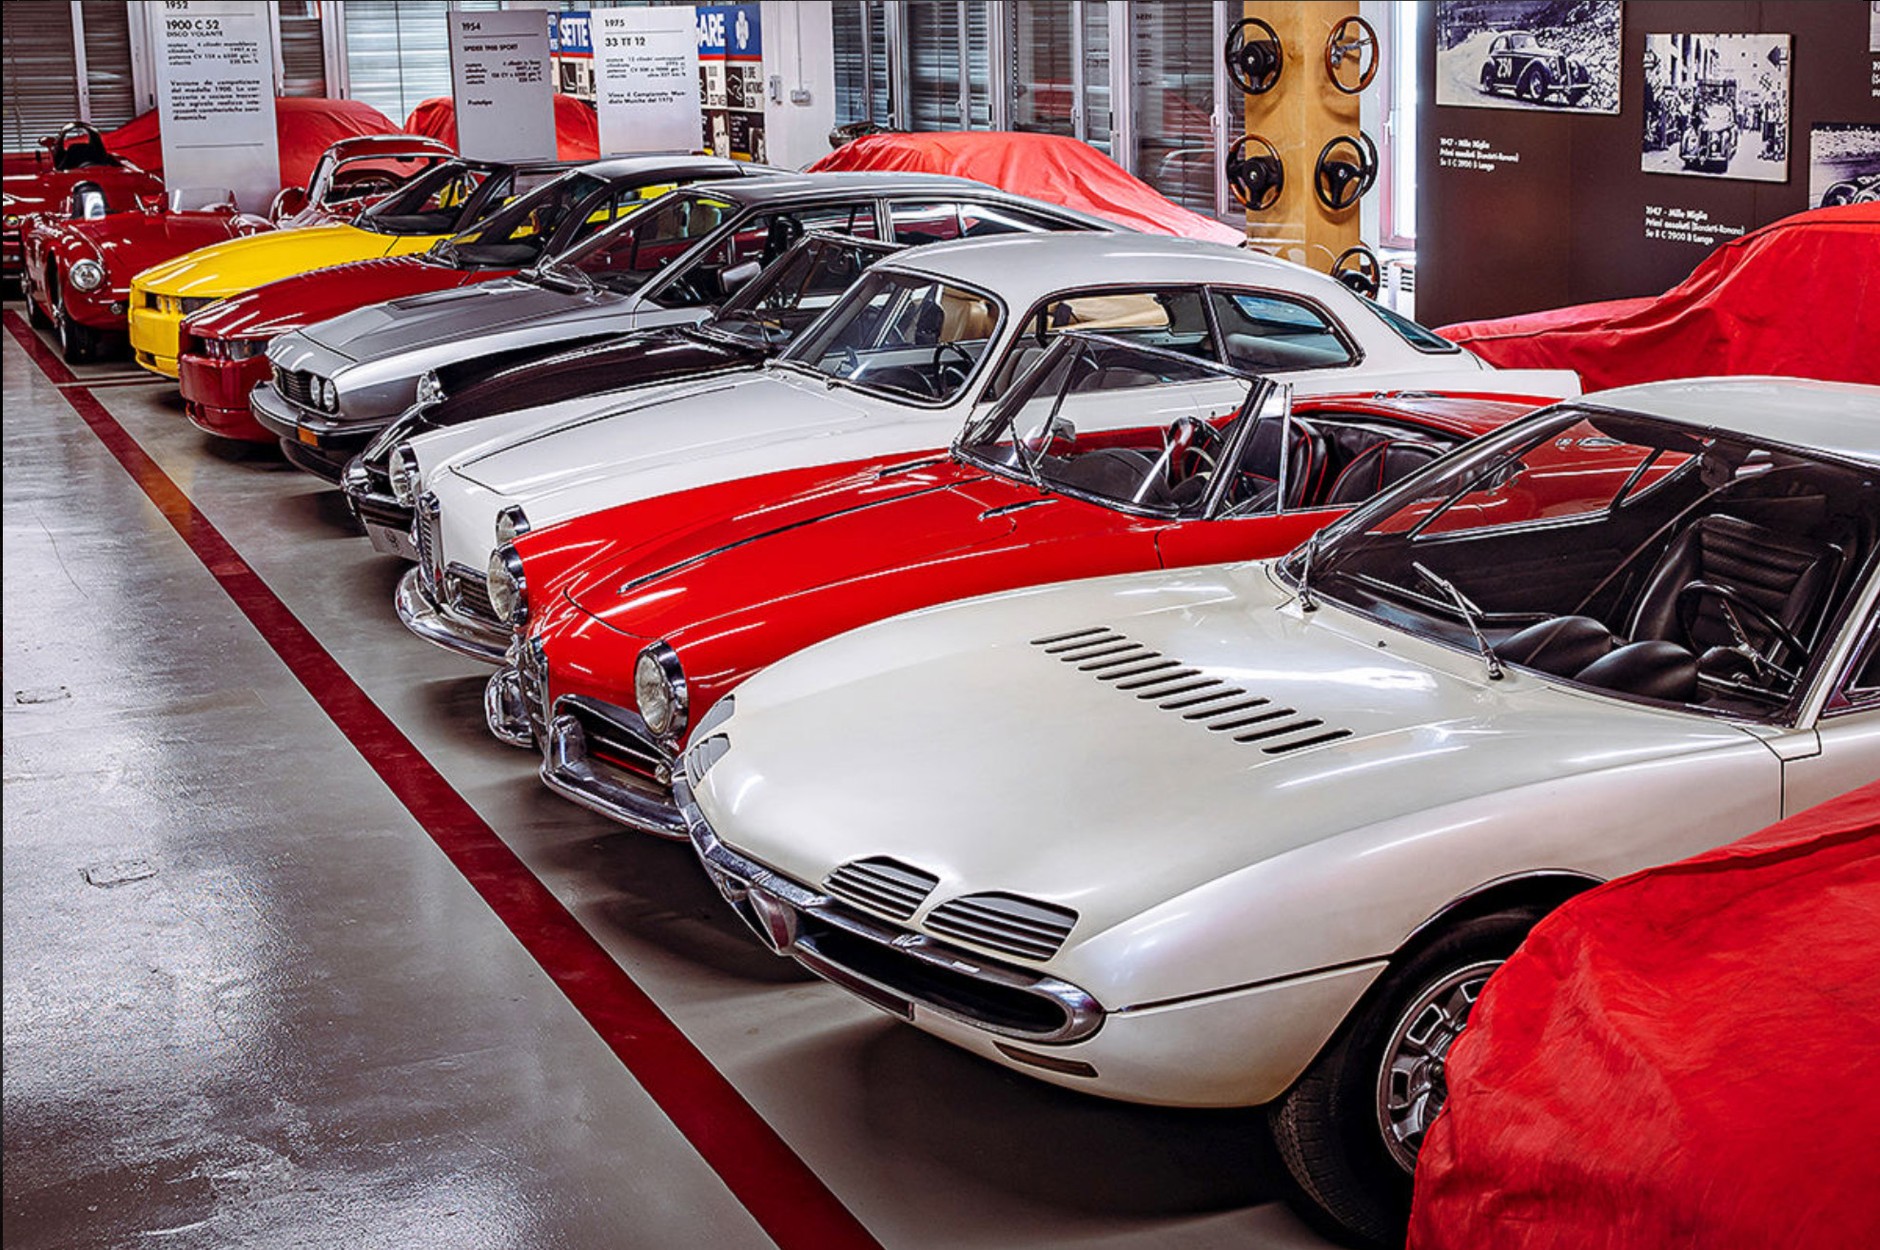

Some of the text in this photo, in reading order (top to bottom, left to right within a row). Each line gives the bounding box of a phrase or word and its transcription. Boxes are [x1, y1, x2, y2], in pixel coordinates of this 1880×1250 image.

[166, 20, 220, 30] 1900 C 52
[462, 22, 481, 31] 1954
[604, 19, 625, 27] 1975
[560, 18, 589, 47] SETTE
[605, 36, 646, 47] 33 TT 12
[499, 43, 518, 51] SPORT
[633, 89, 669, 98] Campionato
[1668, 208, 1685, 218] Mille
[1686, 210, 1708, 221] Miglia
[1645, 218, 1663, 227] Primi
[1664, 220, 1690, 230] assoluti
[1667, 231, 1685, 240] 2900
